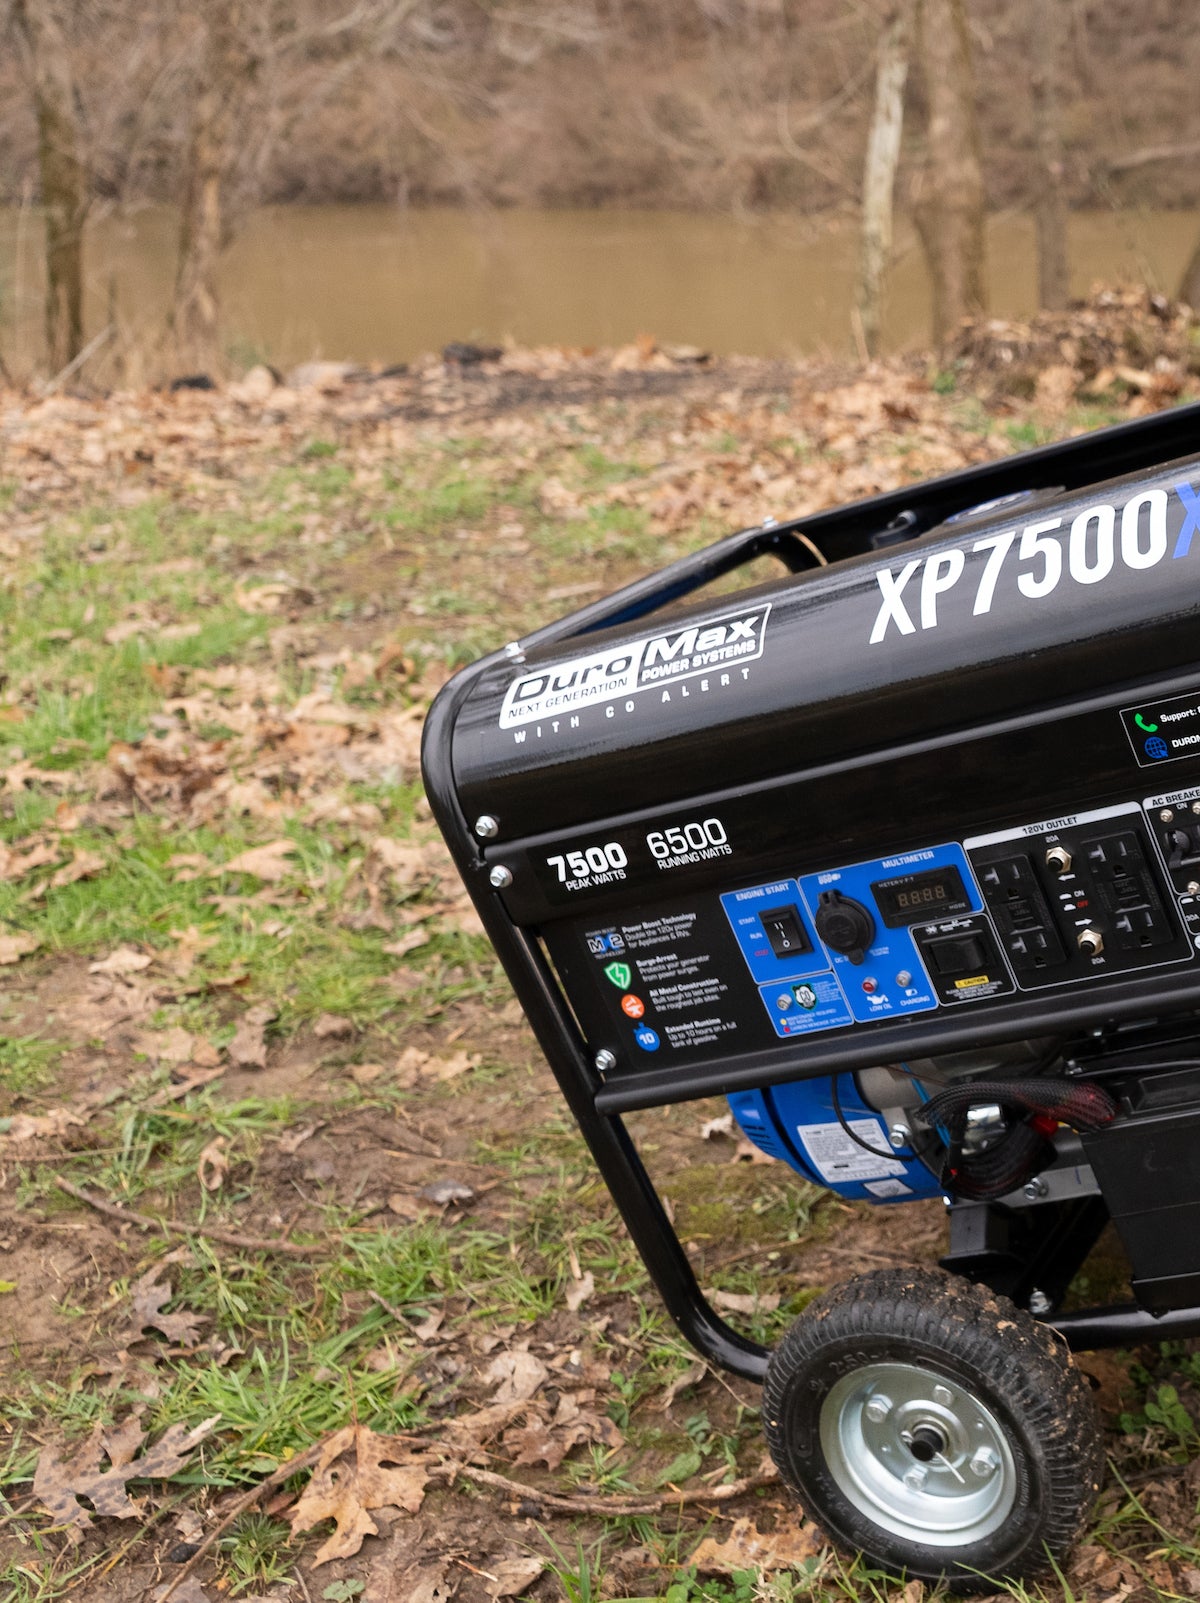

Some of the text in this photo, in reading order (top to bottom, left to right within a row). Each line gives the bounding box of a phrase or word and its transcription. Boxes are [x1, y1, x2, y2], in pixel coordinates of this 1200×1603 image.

[641, 638, 756, 682] POWER SYSTEMS
[508, 677, 628, 719] NEXT GENERATION
[514, 668, 750, 743] WITH CO ALERT
[1160, 709, 1197, 724] Support:
[1152, 797, 1164, 807] AC
[1176, 802, 1188, 811] ON
[1022, 816, 1078, 835] 120V OUTLET
[646, 818, 727, 859] 6500
[1046, 834, 1060, 843] 20A
[546, 841, 628, 883] 7500
[657, 843, 733, 871] RUNNING WATTS
[882, 850, 935, 869] MULTIMETER
[565, 868, 627, 892] PEAK WATTS
[736, 882, 789, 902] ENGINE START
[1074, 890, 1085, 898] ON
[1077, 900, 1089, 909] OFF
[621, 912, 696, 933] Power Boost Technology
[649, 978, 719, 998] All Metal Construction
[665, 1018, 721, 1034] Extended Runtime
[639, 1032, 655, 1044] 10
